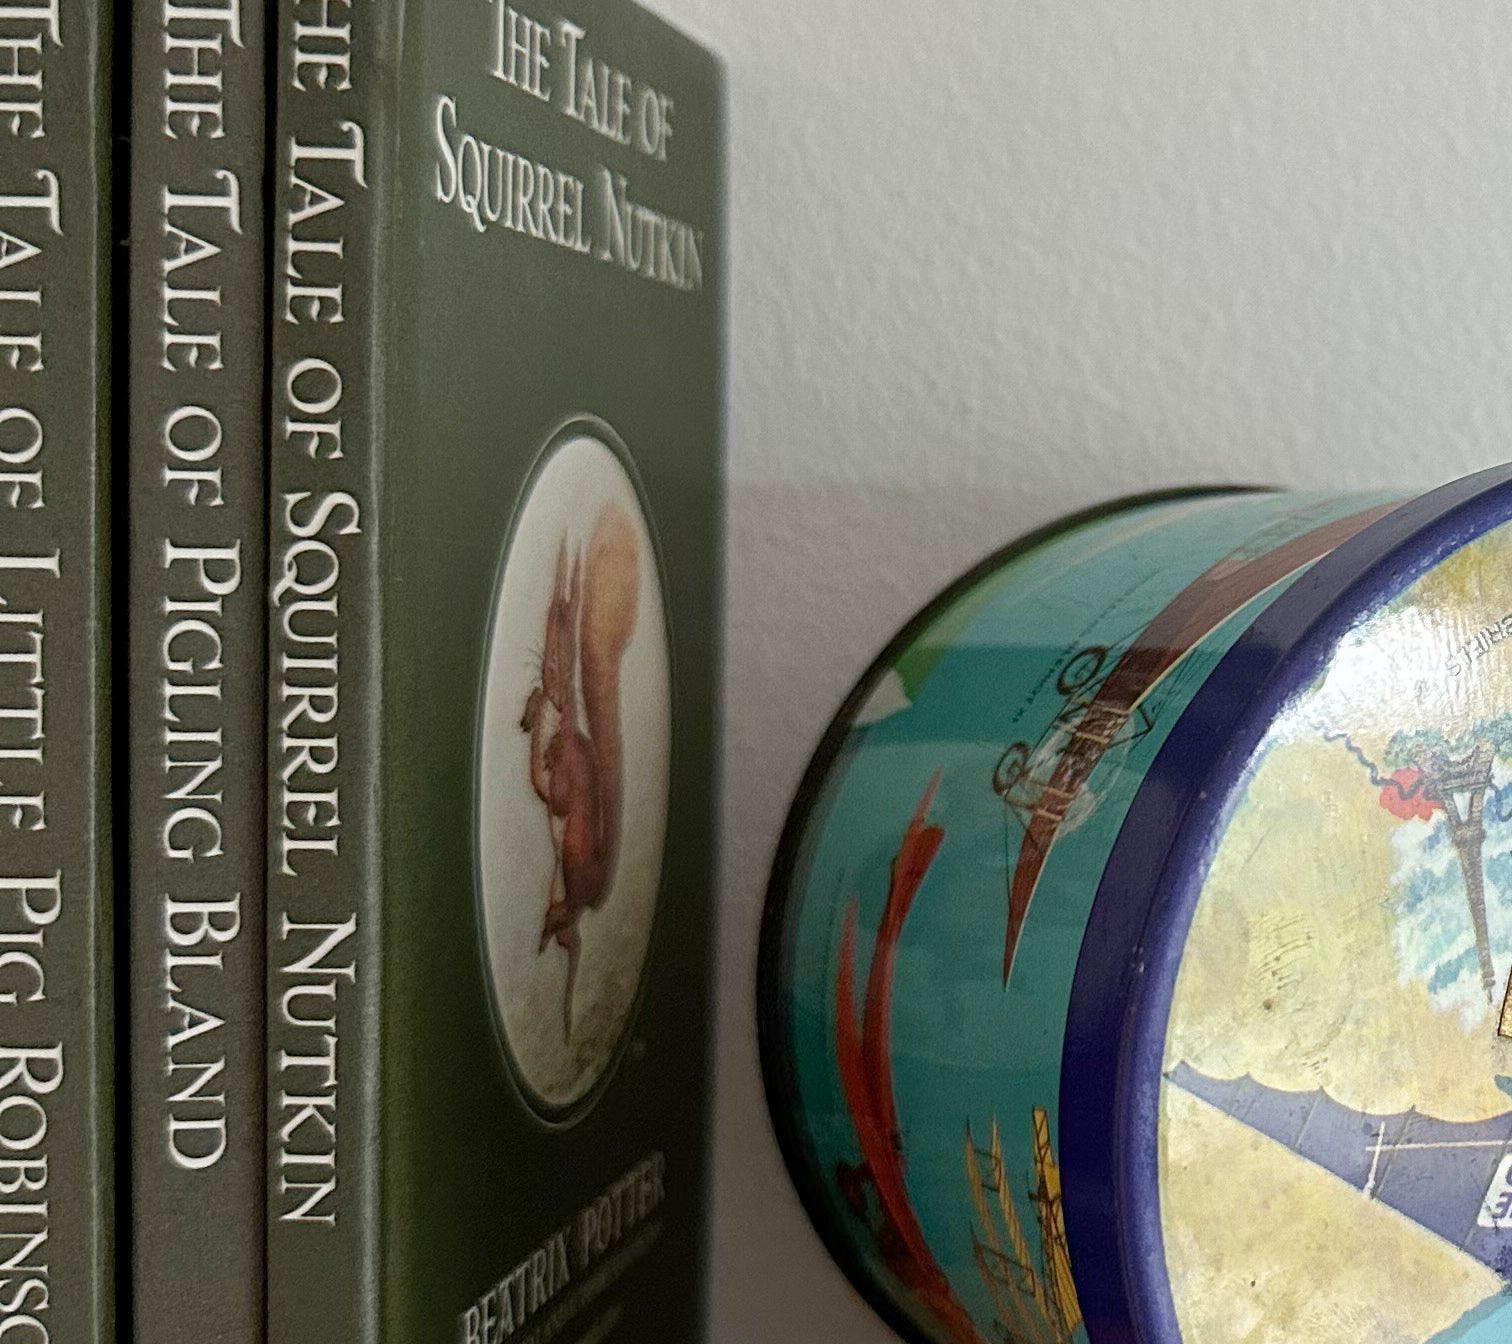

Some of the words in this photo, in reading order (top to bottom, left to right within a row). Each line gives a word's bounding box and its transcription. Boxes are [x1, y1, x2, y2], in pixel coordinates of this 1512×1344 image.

[560, 16, 633, 147] TALE
[637, 84, 676, 163] OF
[161, 168, 243, 373] TALE
[284, 119, 367, 325] TALE
[434, 93, 592, 256] SQUIRREL
[600, 162, 704, 293] NUTKIN
[0, 406, 45, 509] OF
[162, 404, 223, 508] OF
[285, 357, 343, 459] OF
[162, 538, 242, 862] PIGLING
[273, 491, 362, 877] SQUIRREL
[0, 869, 62, 1005] PIG
[164, 891, 242, 1171] BLAND
[279, 911, 358, 1226] NUTKIN
[578, 1152, 666, 1268] POTTER
